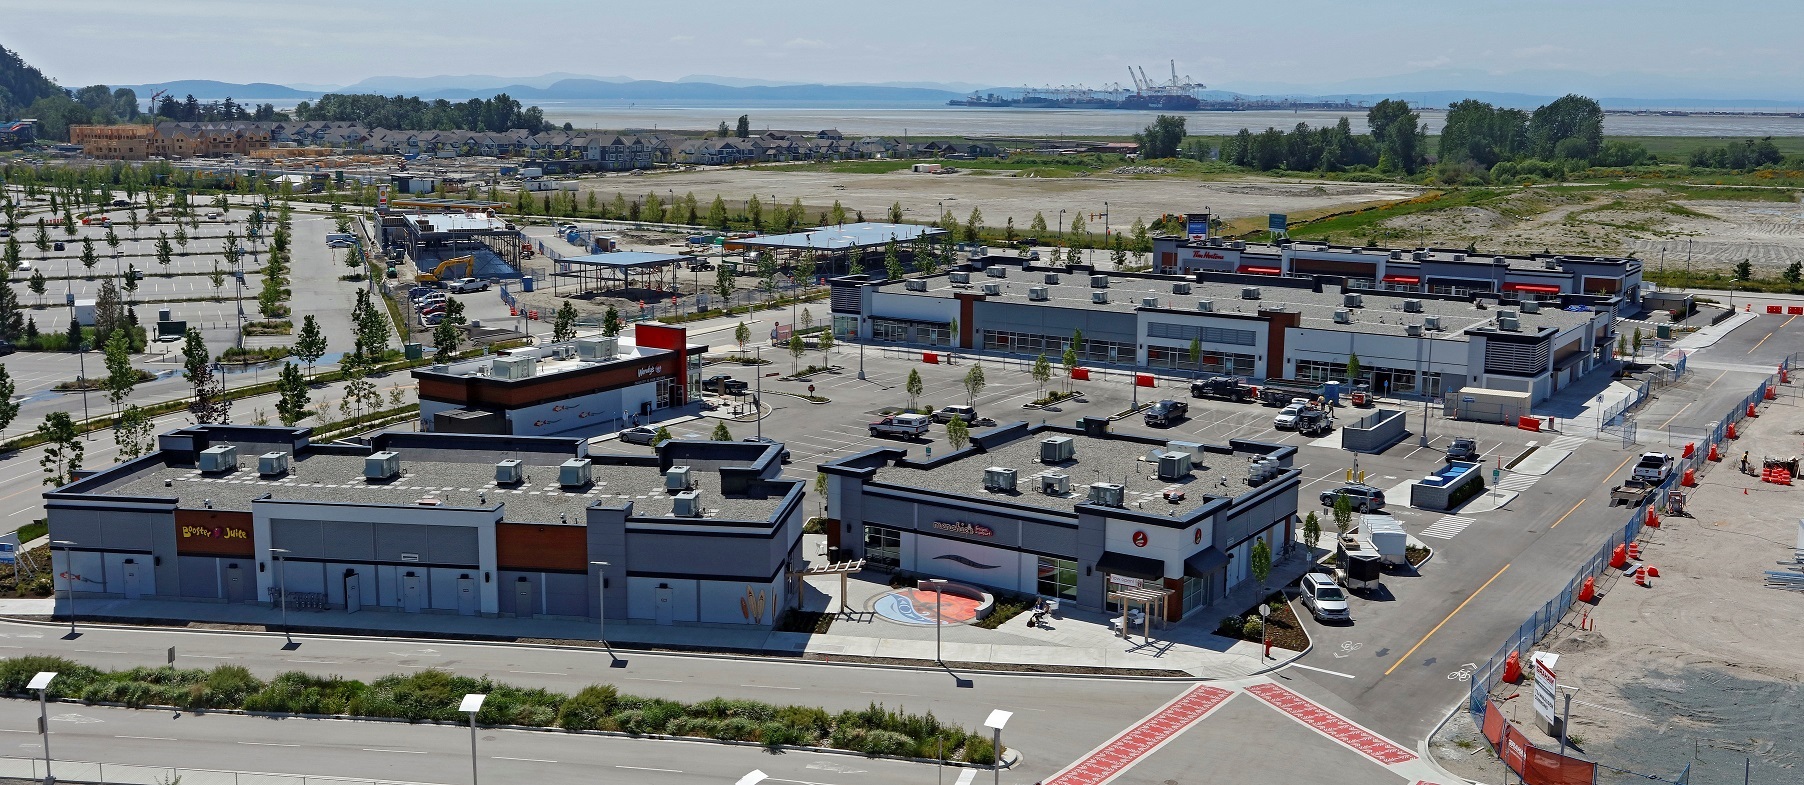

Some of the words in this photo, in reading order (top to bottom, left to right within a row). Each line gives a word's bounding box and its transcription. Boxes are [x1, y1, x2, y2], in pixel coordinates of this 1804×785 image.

[1193, 250, 1203, 258] Tim
[1203, 251, 1224, 260] Hortons
[182, 525, 211, 538] Booster
[223, 527, 247, 539] Juice
